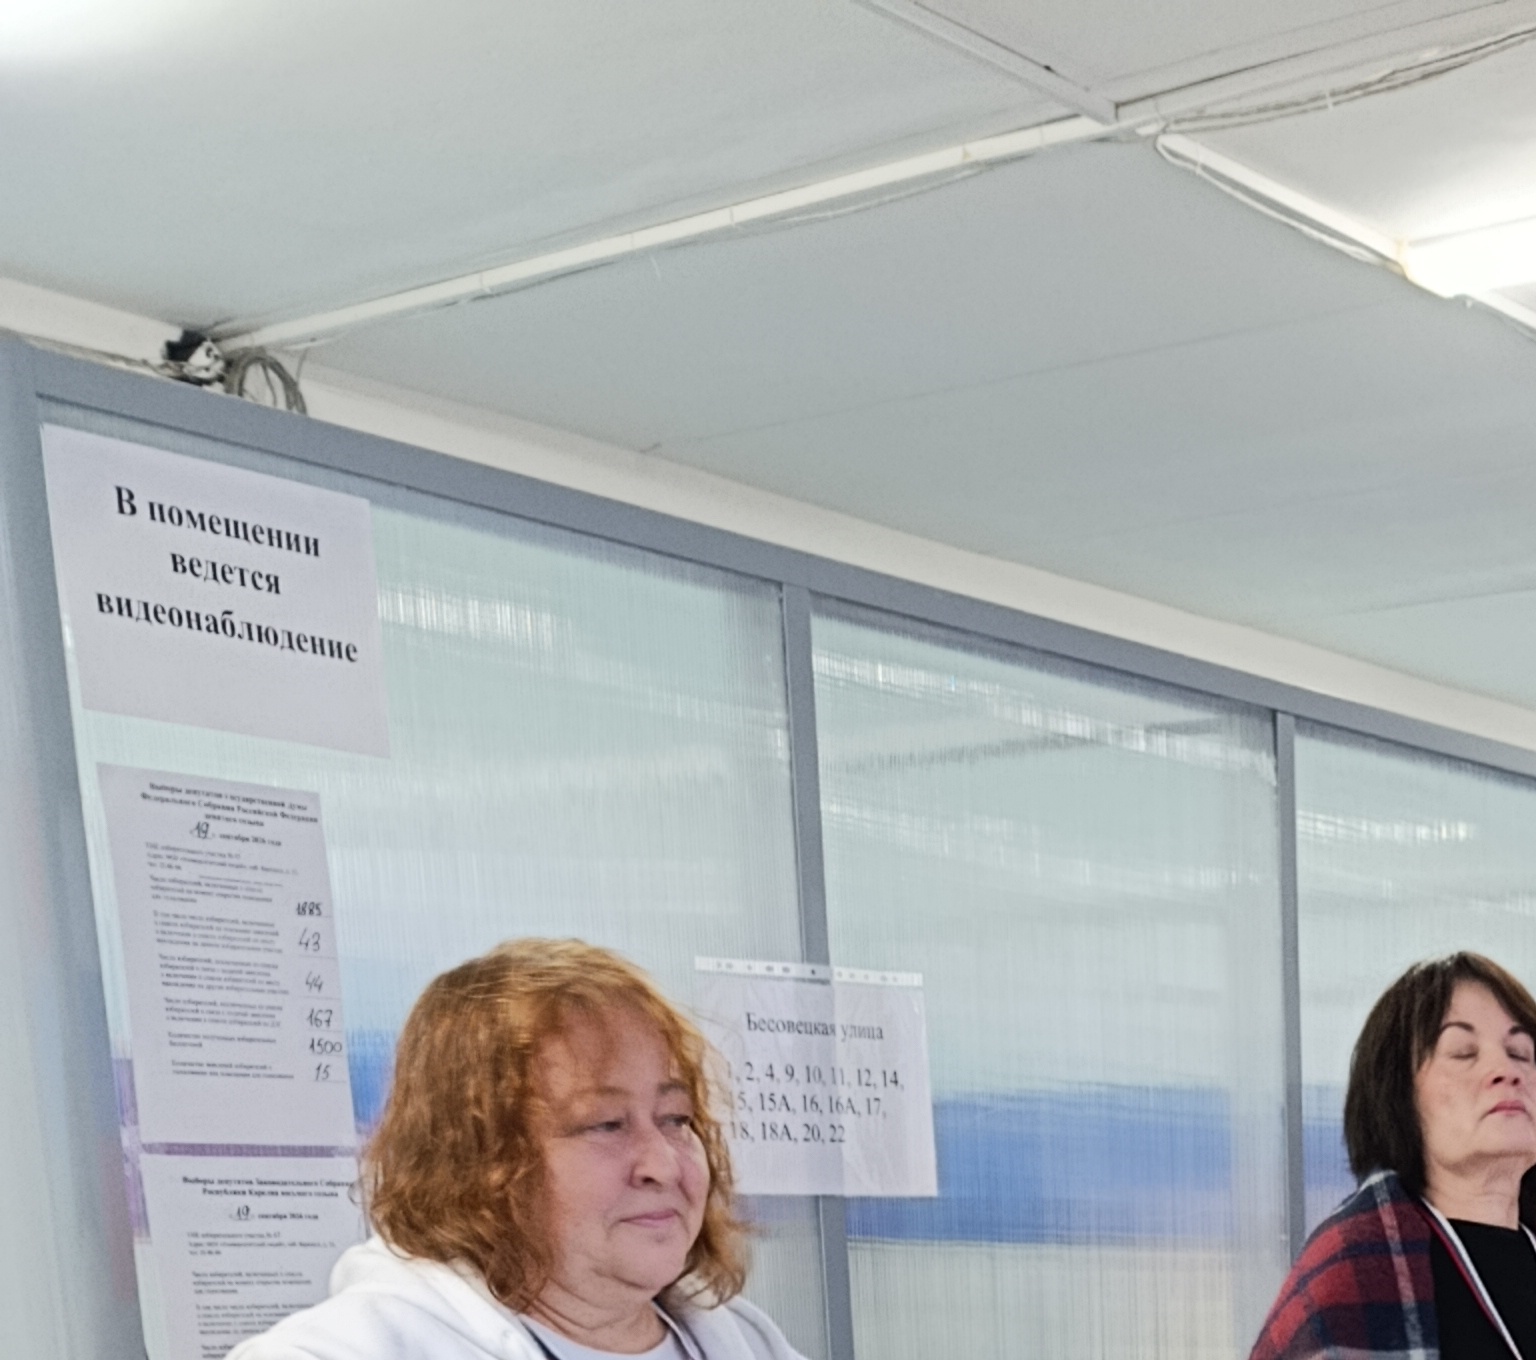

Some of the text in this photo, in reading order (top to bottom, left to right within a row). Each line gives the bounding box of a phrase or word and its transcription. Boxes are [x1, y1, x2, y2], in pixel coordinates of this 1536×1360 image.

[114, 485, 321, 558] В помещении
[170, 552, 281, 596] ведется
[96, 592, 359, 663] видеонаблюдение
[745, 1012, 885, 1043] Бесовецкая улица
[309, 1037, 343, 1055] 1500
[745, 1062, 761, 1084] 2,
[765, 1063, 781, 1084] 4,
[785, 1064, 800, 1085] 9,
[805, 1065, 827, 1086] 10,
[831, 1067, 852, 1087] 11,
[857, 1068, 878, 1089] 12,
[882, 1069, 905, 1091] 14,
[802, 1094, 823, 1116] 16,
[866, 1097, 887, 1118] 17,
[730, 1120, 755, 1143] 18,
[802, 1123, 826, 1144] 20,
[829, 1125, 846, 1143] 22
